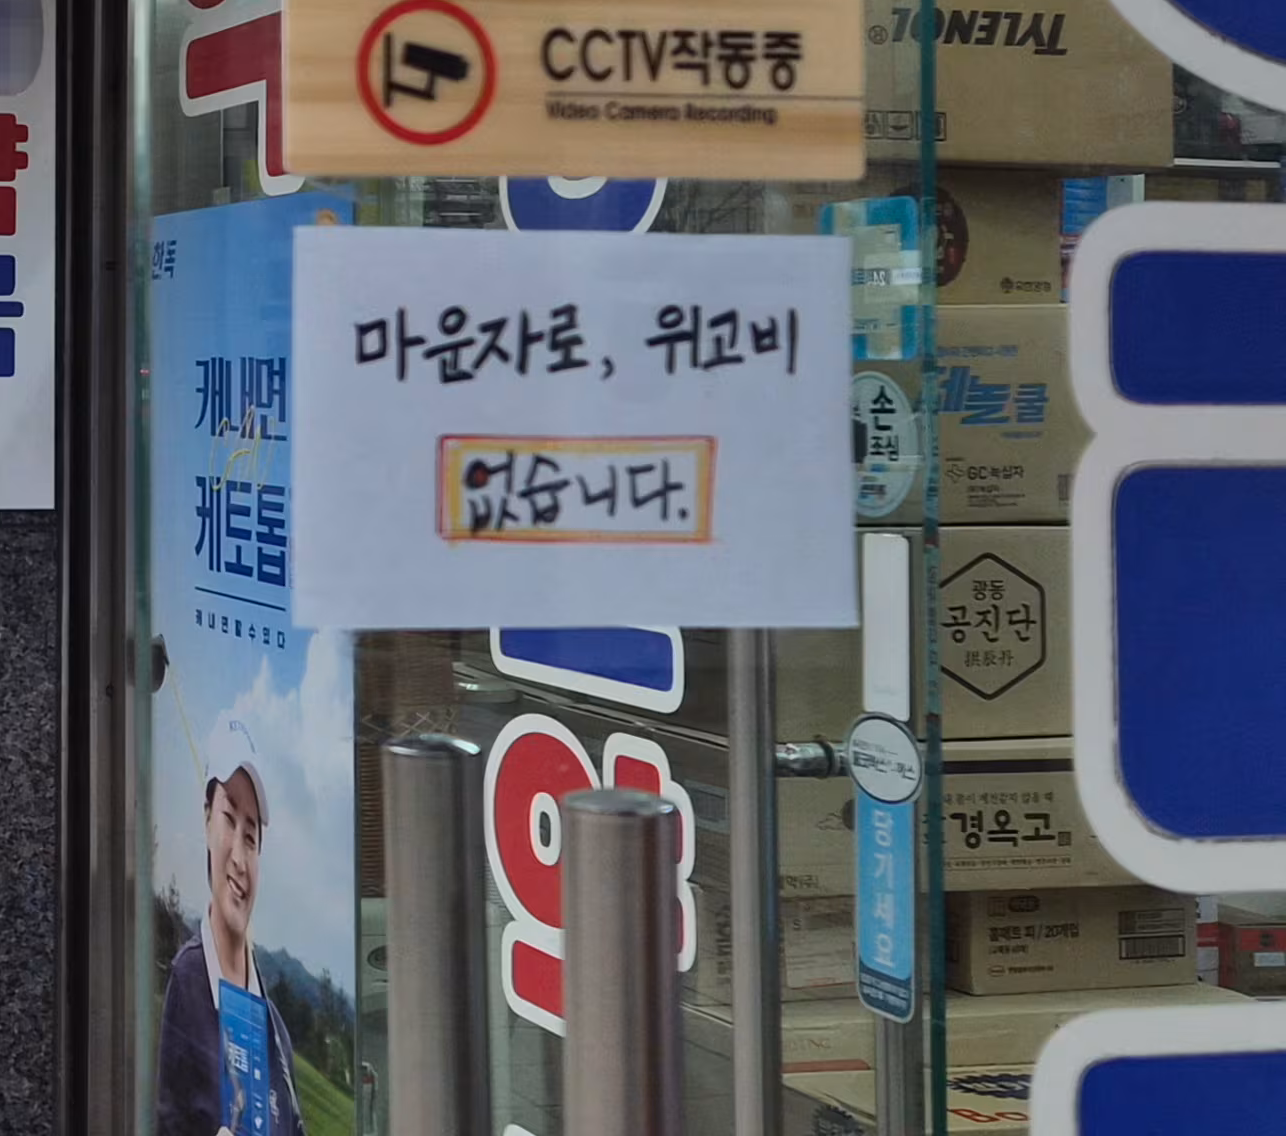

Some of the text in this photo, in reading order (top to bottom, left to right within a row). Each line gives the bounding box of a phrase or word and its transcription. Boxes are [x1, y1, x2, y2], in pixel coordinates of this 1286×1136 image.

[541, 27, 803, 91] CCTV작동중
[546, 101, 778, 125] Video Camera Recording
[354, 303, 799, 385] 마운자로, 위고비
[195, 356, 287, 441] 캐내면
[869, 384, 896, 431] 손
[462, 450, 690, 533] 없습니다.
[195, 476, 287, 588] 케토톱
[972, 579, 1006, 602] 광동
[940, 603, 1037, 644] 공진단
[949, 809, 1056, 849] 경옥고
